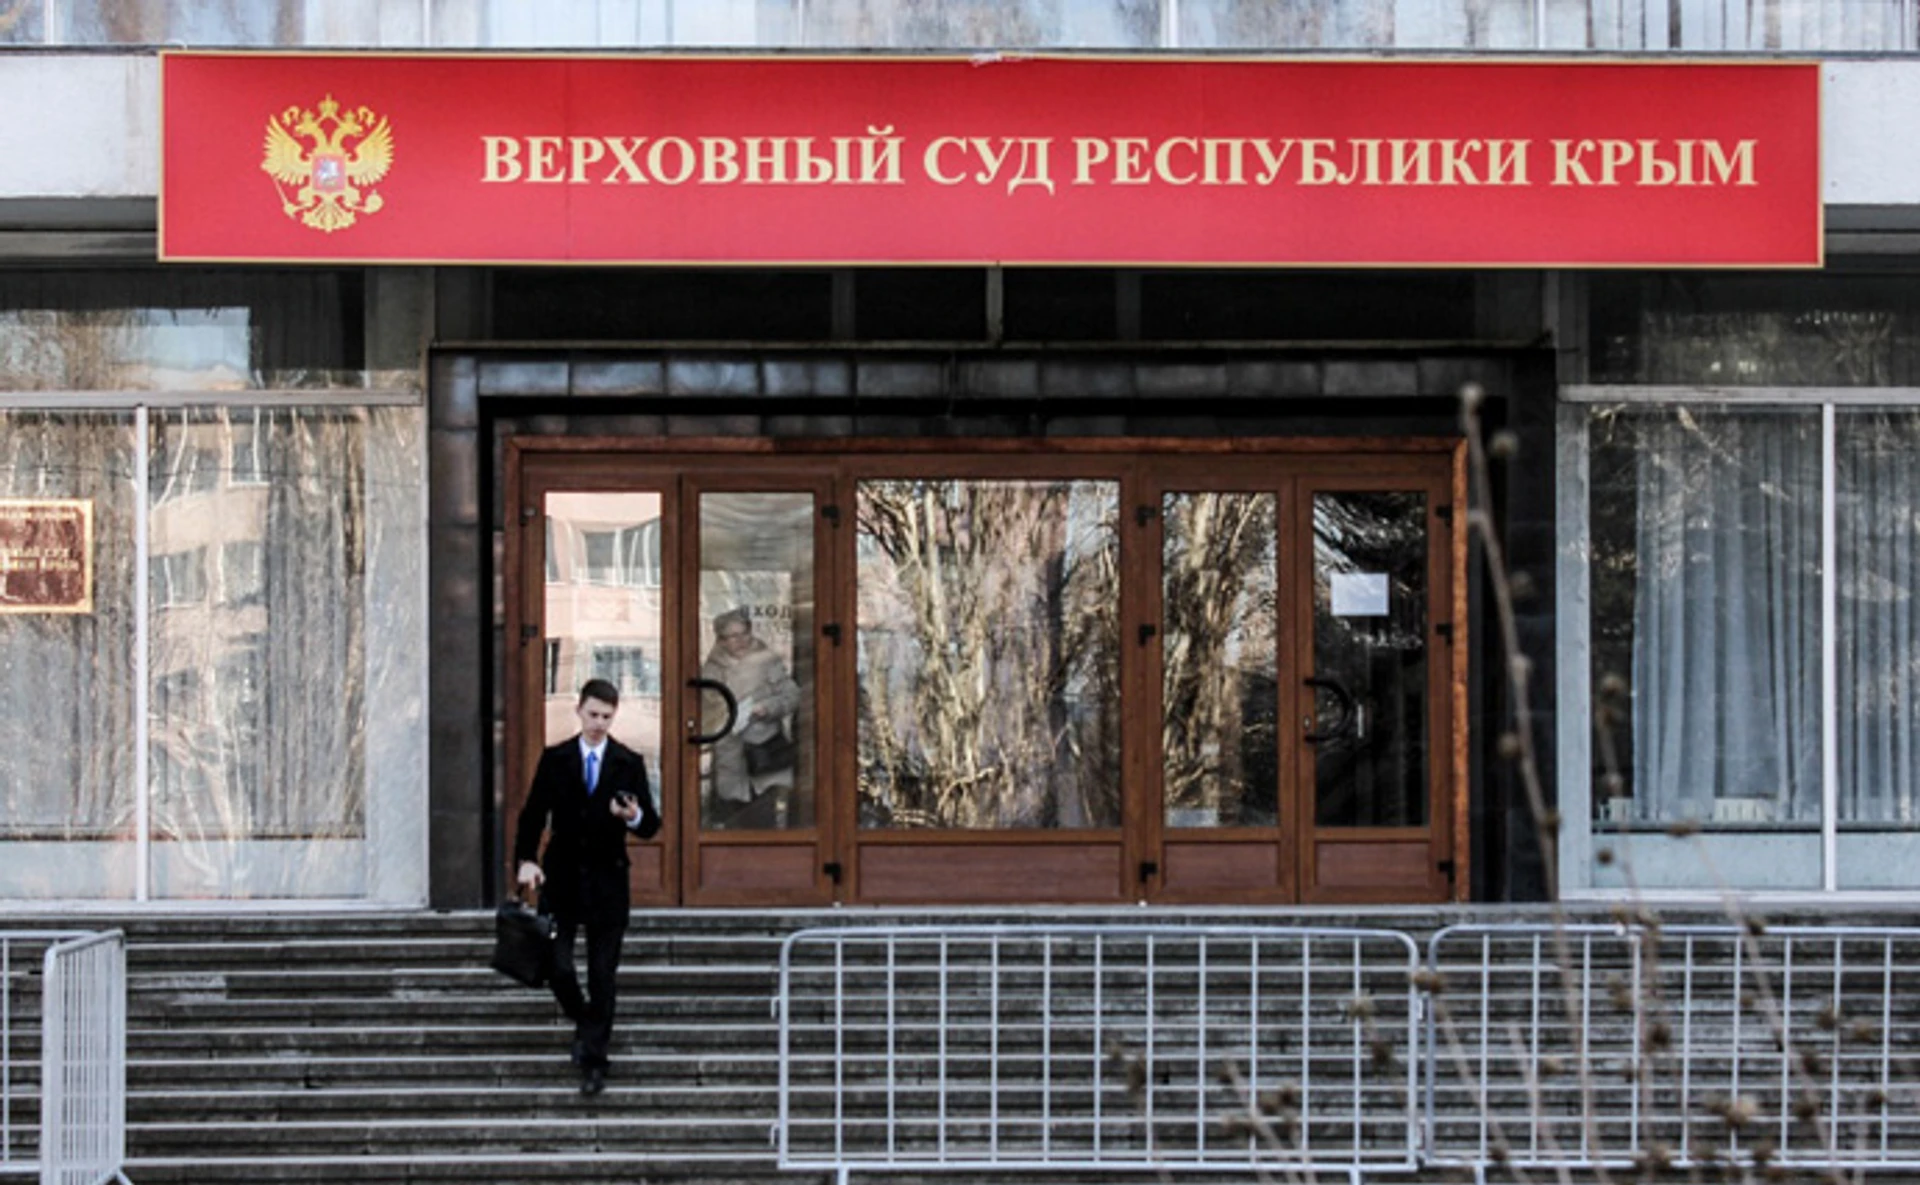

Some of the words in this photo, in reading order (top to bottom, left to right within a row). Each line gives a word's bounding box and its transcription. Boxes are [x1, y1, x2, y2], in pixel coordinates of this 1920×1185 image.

[481, 124, 904, 184] ВЕРХОВНЫЙ
[922, 136, 1055, 195] СУД
[1072, 137, 1530, 185] РЕСПУБЛИКИ
[1551, 139, 1756, 185] КРЫМ
